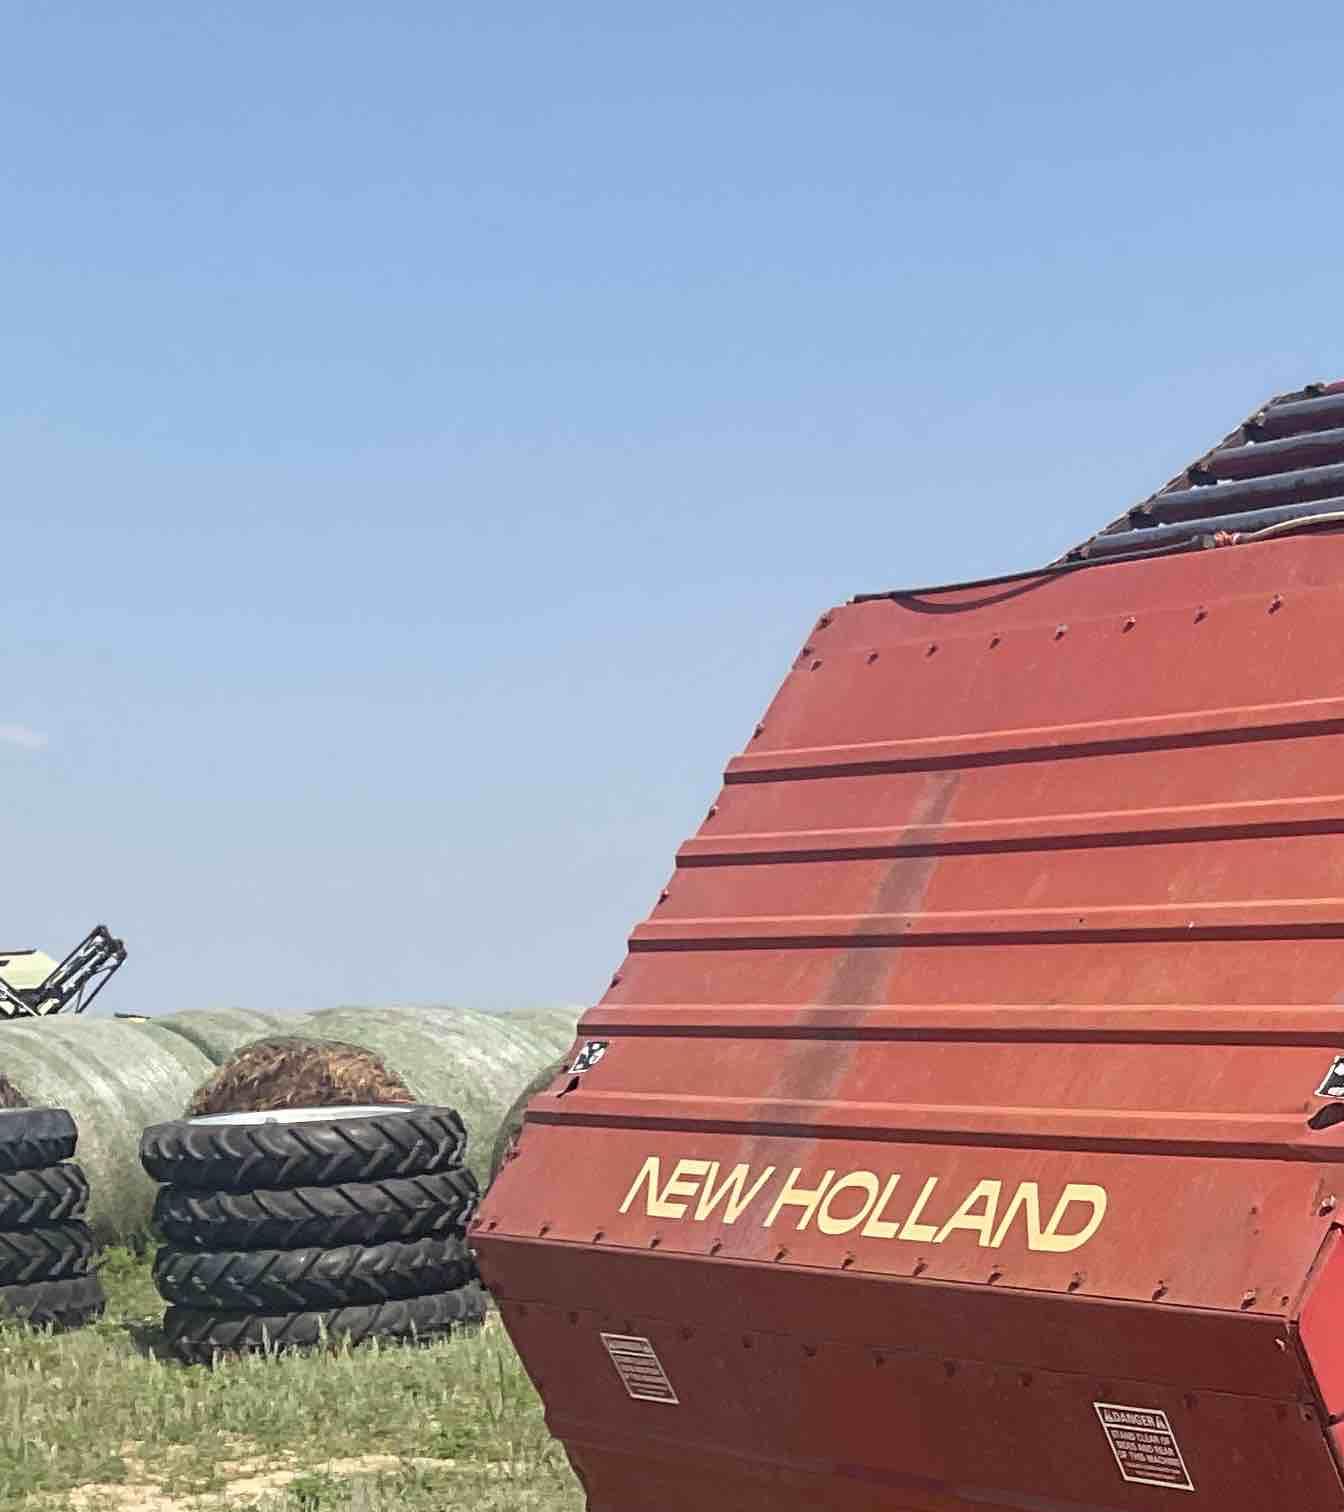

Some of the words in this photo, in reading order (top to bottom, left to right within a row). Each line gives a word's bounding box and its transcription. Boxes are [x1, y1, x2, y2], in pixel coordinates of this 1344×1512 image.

[618, 1156, 776, 1224] NEW
[763, 1167, 1108, 1252] HOLLAND
[1112, 1411, 1156, 1427] DANGER
